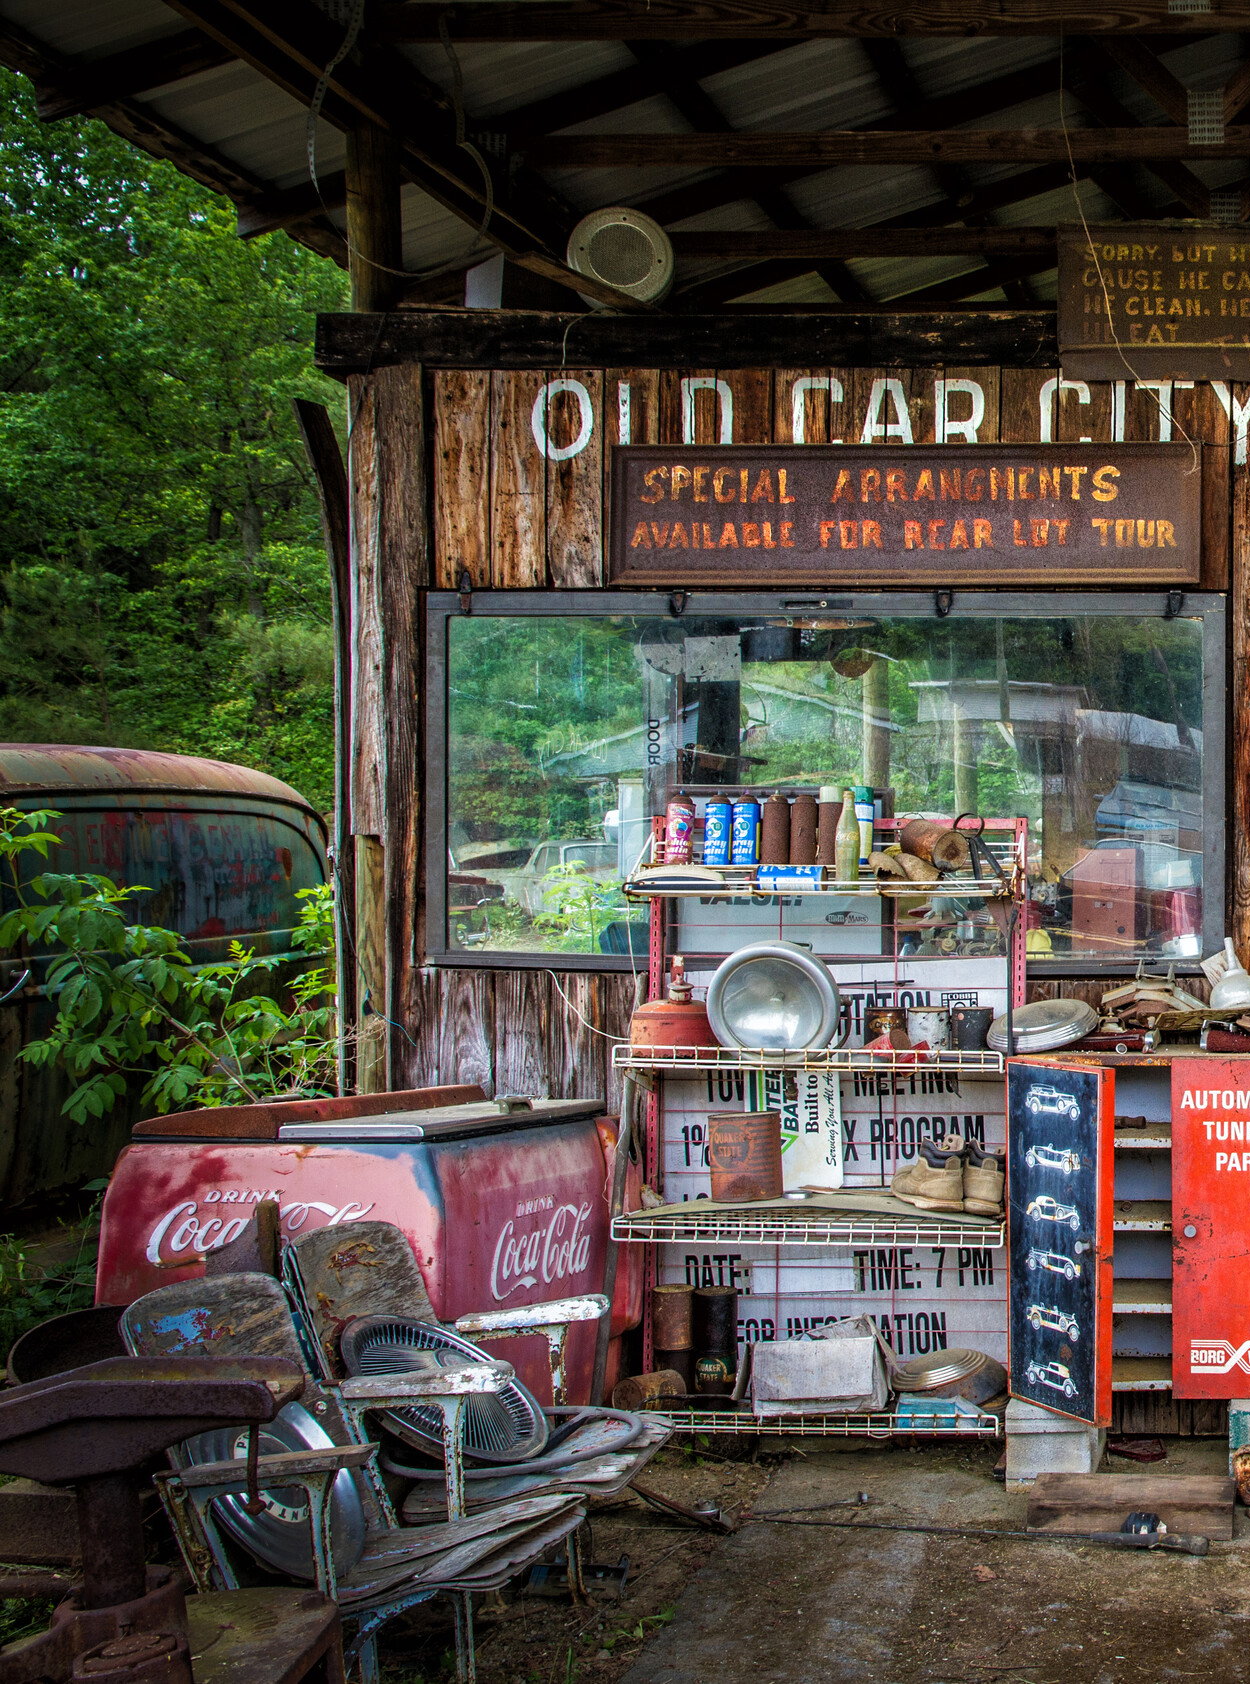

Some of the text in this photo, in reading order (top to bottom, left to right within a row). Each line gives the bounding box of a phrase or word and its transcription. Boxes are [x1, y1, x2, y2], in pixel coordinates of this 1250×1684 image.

[1081, 268, 1164, 291] CAUSE
[1178, 271, 1211, 290] WE
[1083, 294, 1116, 315] WE
[1129, 322, 1181, 344] EAT
[791, 377, 986, 445] CAR
[639, 464, 797, 504] SPECIAL
[630, 517, 1178, 550] AVAILABLE FOR REAR LOT TOUR
[804, 1074, 820, 1135] Built to
[823, 1086, 836, 1108] All
[826, 1104, 840, 1128] You
[714, 1132, 746, 1144] QUAKER
[825, 1126, 839, 1167] Serving
[870, 1114, 986, 1161] PROGRAM
[718, 1146, 743, 1159] STATE
[203, 1188, 285, 1204] DRINK
[515, 1195, 555, 1218] DRINK
[490, 1201, 593, 1301] Coca-Cola
[684, 1246, 996, 1296] DATE: TIME: 7 PM
[1190, 1349, 1226, 1364] BORG
